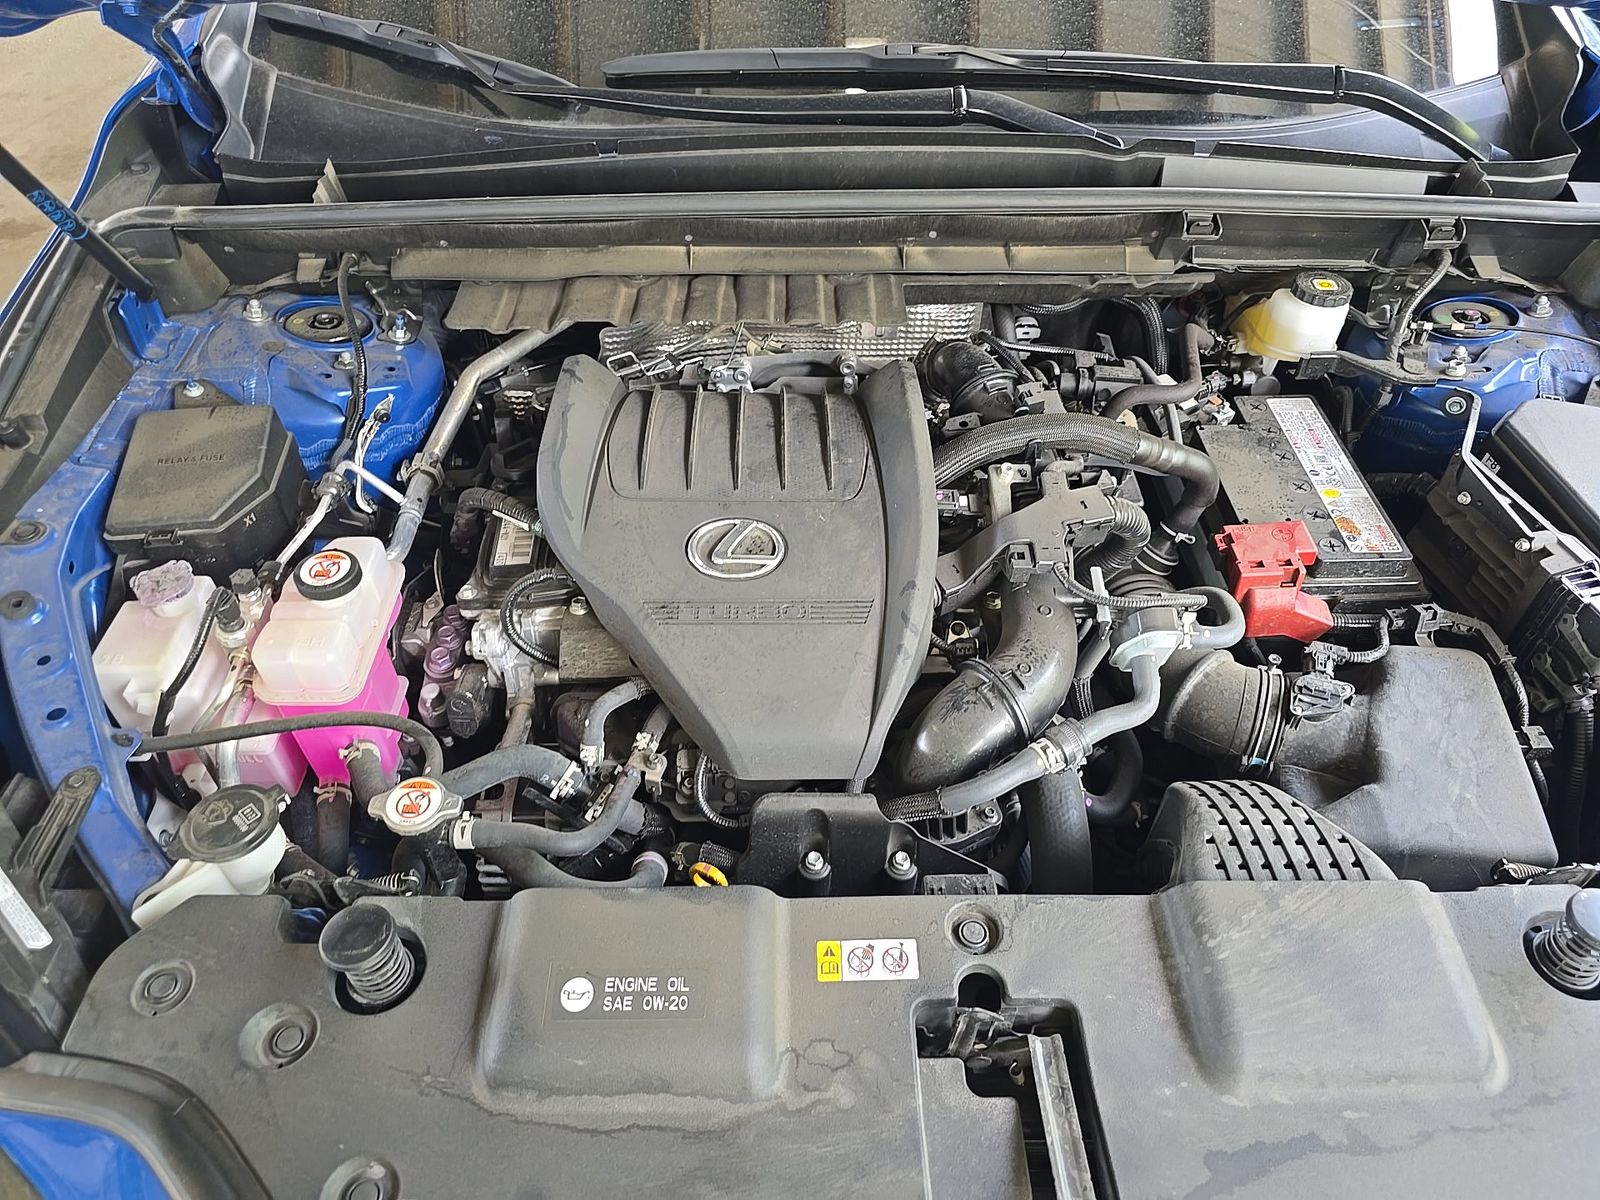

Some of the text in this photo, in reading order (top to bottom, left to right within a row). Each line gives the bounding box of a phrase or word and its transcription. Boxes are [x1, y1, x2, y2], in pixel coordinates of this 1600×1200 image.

[157, 457, 190, 465] RELAY
[200, 453, 225, 462] FUSE
[243, 512, 257, 528] X1
[604, 977, 690, 992] ENGINE OIL
[602, 996, 689, 1011] SAE 0W-20
